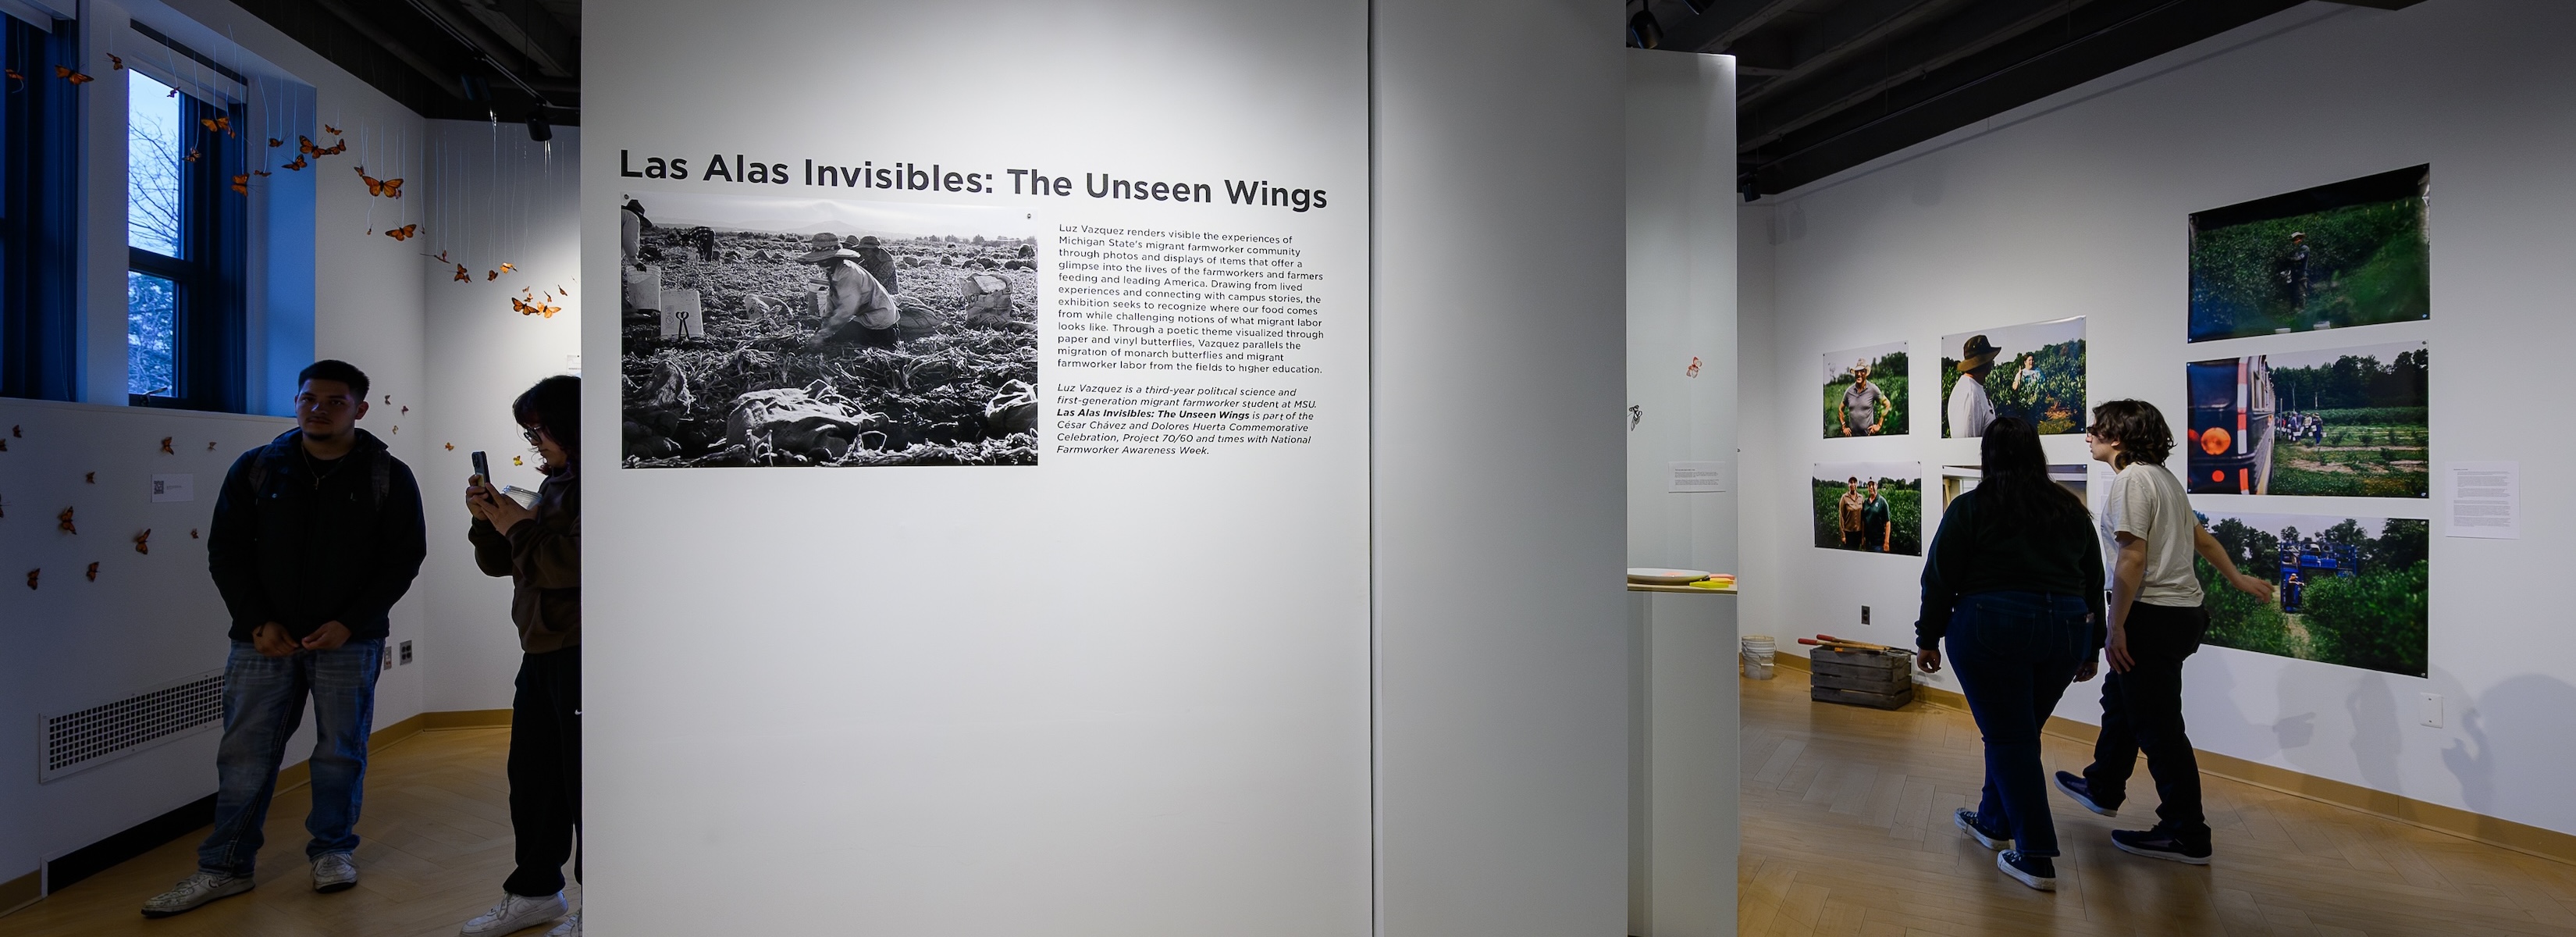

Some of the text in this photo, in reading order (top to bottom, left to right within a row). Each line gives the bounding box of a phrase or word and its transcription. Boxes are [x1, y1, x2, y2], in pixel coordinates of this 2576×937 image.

[621, 149, 1326, 212] Las Alas Invisibles: The Unseen Wings
[1059, 224, 1077, 233] Luz
[1081, 225, 1124, 236] Vazquez
[1127, 229, 1165, 237] renders
[1169, 230, 1201, 240] visible
[1204, 232, 1219, 240] the
[1222, 234, 1280, 244] experiences
[1059, 236, 1300, 258] Michigan State's migrant farmworker community
[1059, 248, 1100, 259] through
[1103, 251, 1138, 260] photos
[1141, 253, 1160, 262] and
[1163, 254, 1204, 265] displays
[1207, 256, 1216, 265] of
[1249, 258, 1268, 266] that
[1271, 258, 1294, 267] offer
[1059, 261, 1099, 271] glimpse
[1103, 262, 1123, 272] into
[1126, 264, 1142, 273] the
[1145, 265, 1167, 273] lives
[1203, 267, 1264, 278] farmworkers
[1287, 271, 1323, 280] farmers
[1059, 273, 1098, 284] feeding
[1123, 276, 1160, 287] leading
[1164, 278, 1208, 287] America.
[1212, 280, 1251, 290] Drawing
[1254, 281, 1277, 290] from
[1280, 282, 1303, 291] lived
[1059, 286, 1120, 296] experiences
[1145, 290, 1201, 301] connecting
[1204, 291, 1225, 300] with
[1268, 294, 1303, 304] stories,
[1306, 295, 1321, 304] the
[1059, 297, 1109, 307] exhibition
[1113, 300, 1140, 308] seeks
[1158, 302, 1206, 312] recognize
[1210, 304, 1240, 312] where
[1261, 305, 1284, 314] food
[1059, 309, 1322, 327] from while challenging notions of what migrant labor
[1059, 322, 1085, 331] looks
[1090, 322, 1108, 332] like.
[1112, 324, 1155, 335] Through
[1167, 326, 1199, 336] poetic
[1201, 327, 1233, 336] theme
[1236, 328, 1283, 337] visualized
[1286, 330, 1324, 340] through
[1058, 336, 1088, 344] paper
[1114, 337, 1137, 347] vinyl
[1140, 337, 1194, 348] butterflies,
[1198, 339, 1240, 349] Vazquez
[1243, 340, 1283, 350] parallels
[1286, 341, 1301, 350] the
[1058, 346, 1107, 357] migration
[1172, 350, 1222, 359] butterflies
[1247, 352, 1284, 362] migrant
[1058, 358, 1117, 369] farmworker
[1120, 361, 1147, 369] labor
[1150, 362, 1173, 370] from
[1176, 362, 1193, 371] the
[1196, 362, 1222, 372] fields
[1272, 365, 1322, 373] education.
[1057, 383, 1076, 392] Luz
[1080, 384, 1123, 394] Vazquez
[1125, 385, 1133, 394] is
[1145, 386, 1195, 396] third-year
[1240, 387, 1276, 397] science
[1278, 388, 1297, 397] and
[1057, 395, 1137, 406] first-generation
[1140, 397, 1180, 408] migrant
[1183, 398, 1240, 408] farmworker
[1242, 400, 1279, 408] student
[1056, 408, 1075, 417] Las
[1077, 408, 1101, 417] Alas
[1103, 409, 1155, 418] Invisibles:
[1179, 410, 1216, 419] Unseen
[1219, 411, 1250, 421] Wings
[1252, 411, 1260, 419] is
[1286, 411, 1297, 420] of
[1298, 411, 1314, 420] the
[1057, 420, 1087, 429] César
[1090, 421, 1126, 429] Chávez
[1151, 422, 1189, 431] Dolores
[1193, 422, 1226, 431] Huerta
[1229, 422, 1308, 432] Commemorative
[1057, 433, 1119, 443] Celebration,
[1123, 433, 1159, 444] Project
[1162, 433, 1194, 444] 70/60
[1196, 434, 1215, 443] and
[1247, 435, 1268, 444] with
[1271, 435, 1311, 444] National
[1056, 445, 1209, 454] Farmworker Awareness Week.
